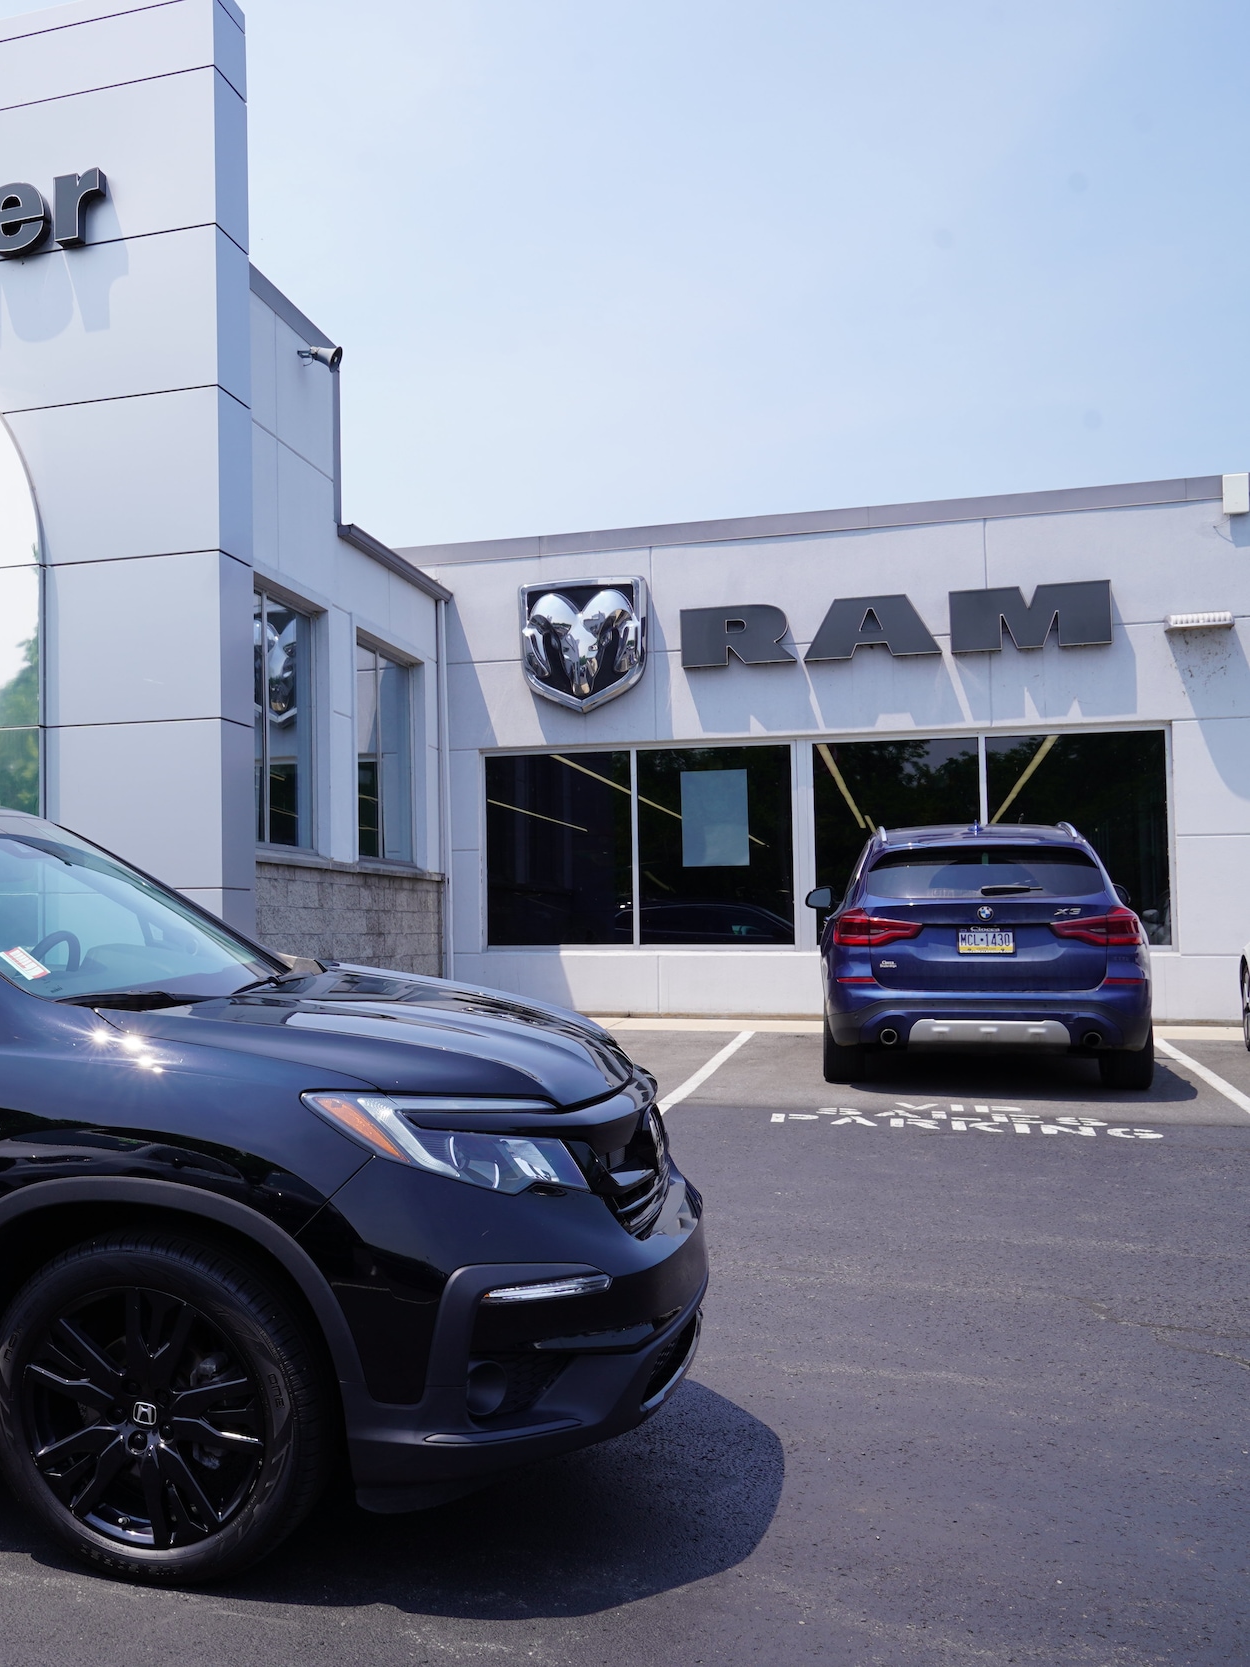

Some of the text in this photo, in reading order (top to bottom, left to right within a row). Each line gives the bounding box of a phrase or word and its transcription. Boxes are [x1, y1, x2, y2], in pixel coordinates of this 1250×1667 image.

[680, 579, 1113, 669] RAM
[1053, 907, 1081, 916] X3
[816, 1107, 1108, 1126] SALES
[895, 1102, 1022, 1112] VIP
[770, 1113, 1164, 1140] PARKING
